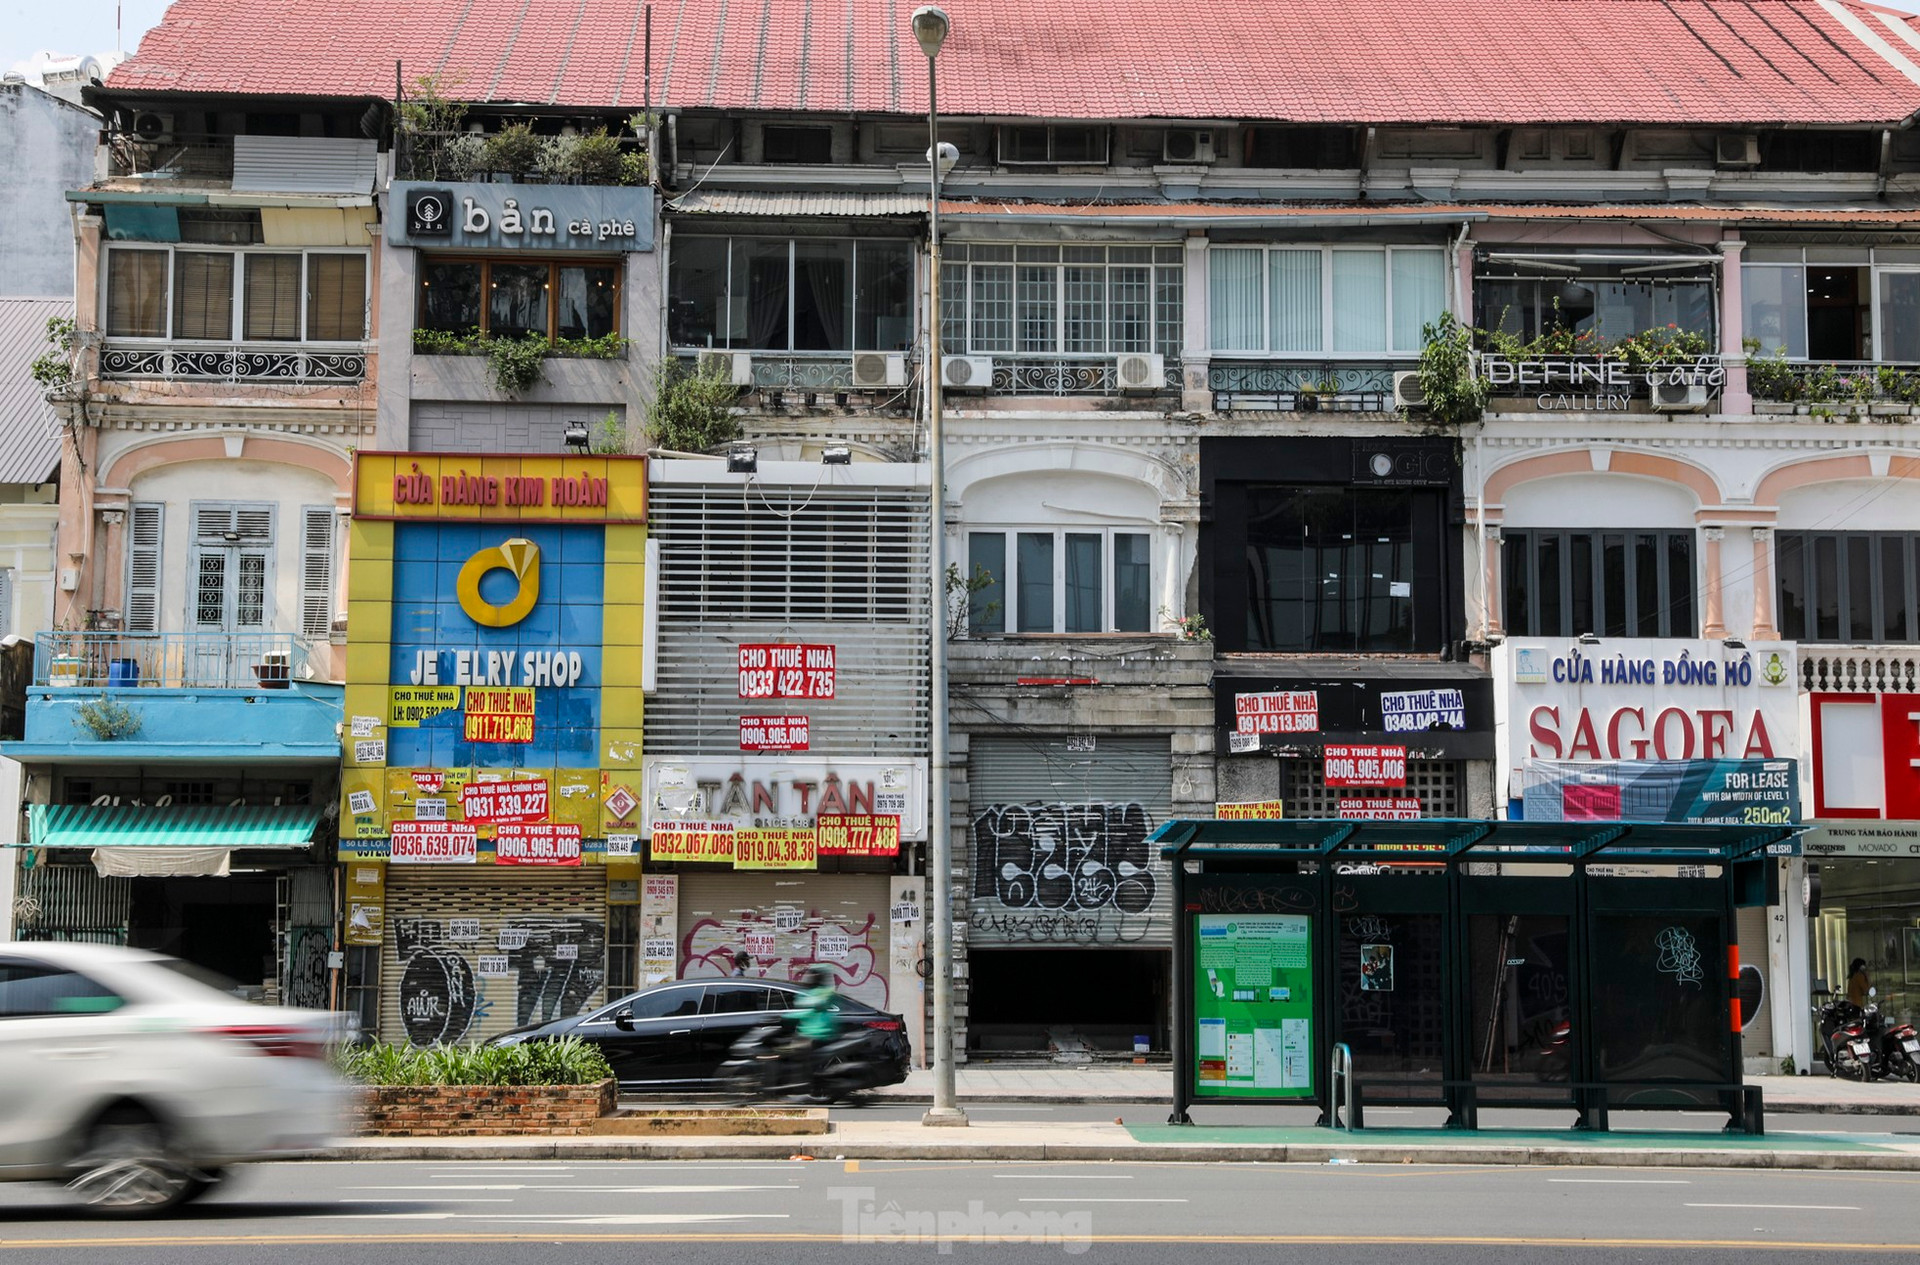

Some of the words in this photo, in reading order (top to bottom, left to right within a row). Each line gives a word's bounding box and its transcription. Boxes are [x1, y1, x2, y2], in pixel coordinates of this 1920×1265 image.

[463, 197, 556, 235] bản
[568, 218, 593, 235] cà
[598, 219, 635, 240] phê
[1489, 361, 1630, 385] DEFINE
[1537, 393, 1631, 411] GALLERY
[393, 462, 434, 504] CỬA
[441, 469, 498, 506] HÀNG
[504, 476, 544, 507] KIM
[552, 471, 608, 508] HOÀN
[740, 648, 766, 668] CHO
[770, 645, 802, 668] THUÊ
[806, 646, 834, 669] NHÀ
[523, 650, 582, 687] SHOP
[1552, 648, 1594, 684] CỬA
[1601, 653, 1655, 685] HÀNG
[1662, 648, 1717, 686] ĐỒNG
[1724, 651, 1752, 687] HỒ
[740, 670, 774, 696] 0933
[778, 670, 804, 696] 422
[808, 671, 833, 697] 735
[394, 691, 412, 701] CHO
[413, 689, 434, 701] THUÊ
[437, 690, 454, 701] NHÀ
[467, 692, 485, 711] CHO
[488, 688, 511, 712] THUÊ
[514, 689, 533, 713] NHÀ
[1237, 697, 1259, 712] CHO
[1261, 692, 1290, 711] THUÊ
[1293, 691, 1316, 710] NHÀ
[1382, 696, 1405, 712] CHO
[1408, 691, 1435, 710] THUÊ
[393, 706, 405, 720] LH:
[762, 717, 786, 725] THUÊ
[788, 716, 807, 725] NHÀ
[465, 716, 532, 740] 0911.719.668
[1238, 714, 1317, 732] 0914.913.580
[741, 727, 808, 744] 0906.905.006
[1326, 748, 1348, 756] CHO
[1351, 747, 1377, 757] THUÊ
[1381, 746, 1404, 757] NHÀ
[412, 774, 433, 782] CHO
[1326, 759, 1405, 779] 0906.905.006
[465, 786, 479, 796] CHO
[480, 784, 496, 795] THUÊ
[497, 783, 511, 794] NHÀ
[511, 782, 531, 793] CHÍNH
[533, 780, 547, 792] CHỦ
[1725, 773, 1749, 789] FOR
[1752, 772, 1788, 788] LEASE
[697, 772, 778, 814] TÂN
[792, 772, 874, 814] TÂN
[1702, 792, 1720, 801] WITH
[1720, 792, 1732, 801] 8M
[1732, 791, 1753, 801] WIDTH
[1754, 791, 1762, 800] OF
[1763, 791, 1784, 800] LEVEL
[1785, 791, 1789, 800] 1
[465, 794, 547, 818] 0931.339.227
[1341, 800, 1363, 808] CHO
[1366, 798, 1393, 808] THUÊ
[1396, 798, 1419, 809] NHÀ
[819, 817, 842, 826] CHO
[844, 815, 871, 826] THUÊ
[874, 816, 898, 827] NHÀ
[1743, 806, 1790, 824] 250m2
[393, 825, 416, 833] CHO
[421, 823, 448, 833] THUÊ
[498, 826, 521, 834] CHO
[524, 824, 552, 835] THUÊ
[555, 824, 580, 835] NHÀ
[680, 821, 707, 831] THUÊ
[711, 821, 734, 831] NHÀ
[737, 831, 758, 840] CHO
[762, 830, 788, 839] THUÊ
[792, 830, 814, 839] NHÀ
[1857, 828, 1875, 836] TÂM
[1894, 828, 1918, 837] HÀNH
[392, 836, 475, 856] 0936.639.074
[653, 833, 734, 855] 0932.067.086
[819, 826, 897, 849] 0908.777.488
[497, 837, 580, 859] 0906.905.006
[737, 841, 815, 861] 0919.04.38.38
[1858, 844, 1898, 852] MOVADO
